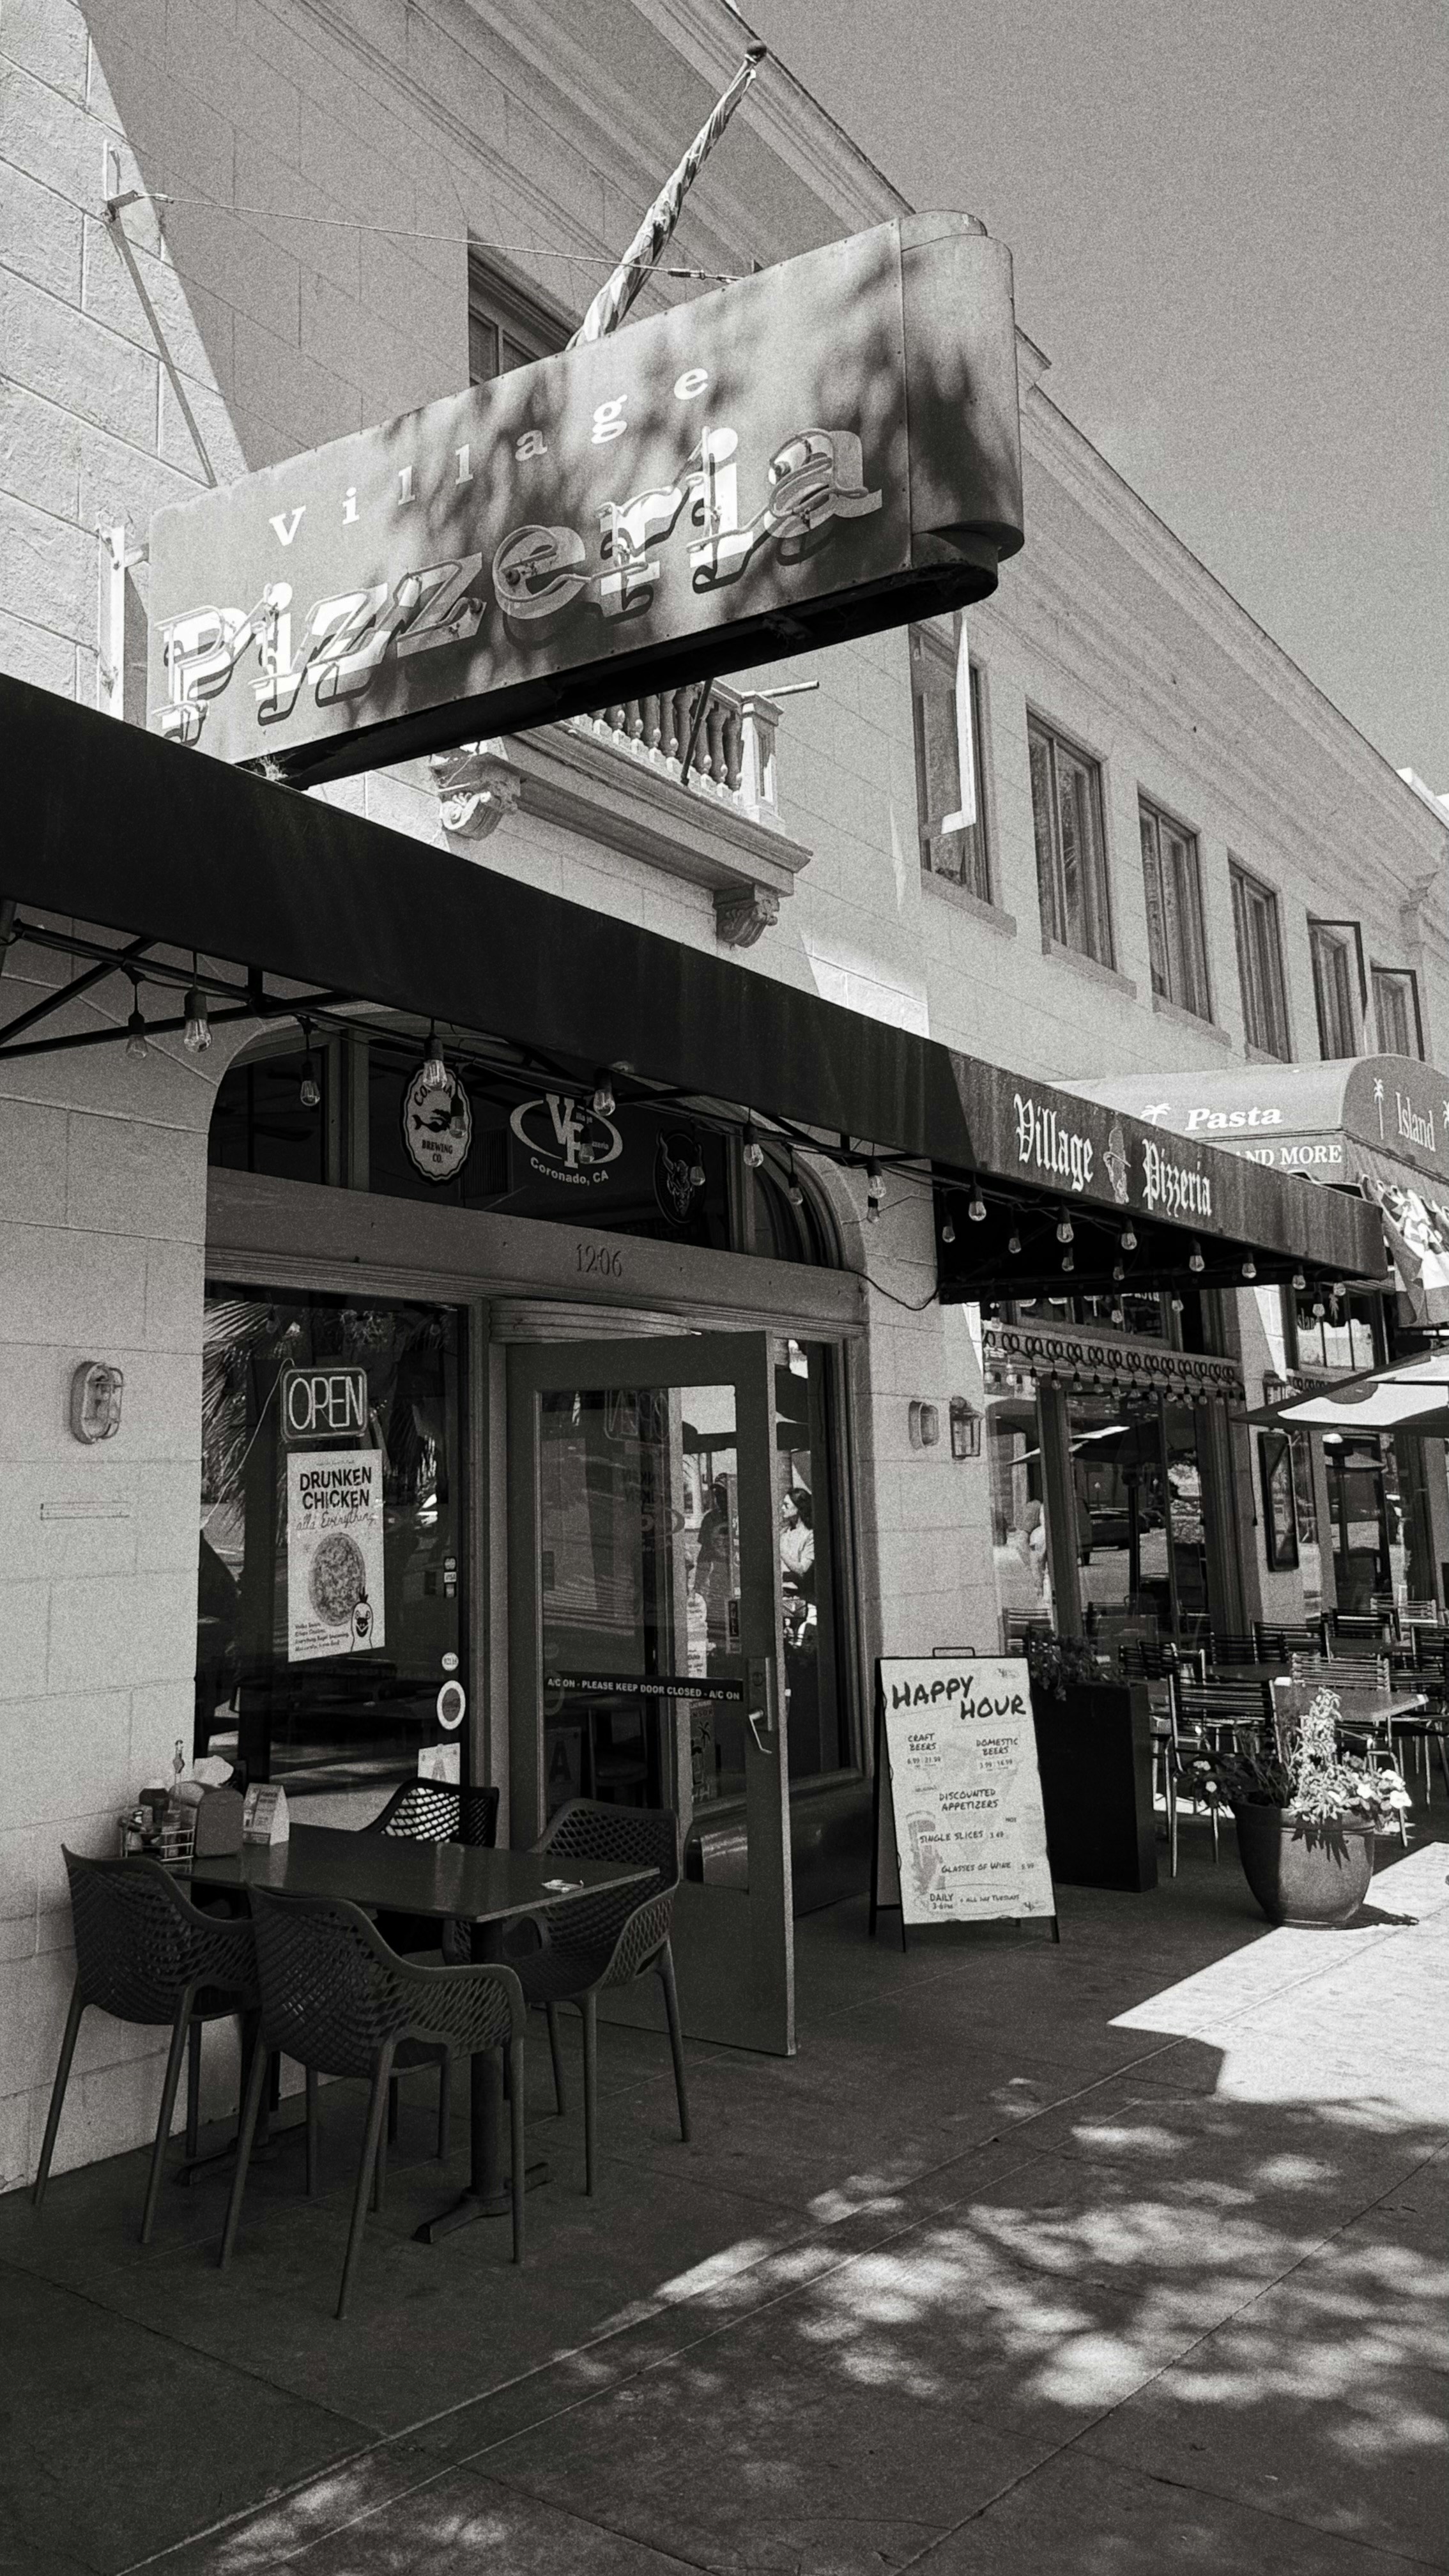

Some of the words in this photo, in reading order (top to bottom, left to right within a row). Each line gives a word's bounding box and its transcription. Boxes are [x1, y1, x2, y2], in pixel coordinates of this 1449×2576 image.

[269, 367, 709, 546] village
[153, 426, 882, 728] Pizzeria
[1184, 1107, 1283, 1131] Pasta
[1395, 1092, 1436, 1152] Island
[422, 1139, 453, 1155] BREWING
[1014, 1093, 1093, 1192] Village
[1142, 1138, 1212, 1218] Pizzeria
[1235, 1148, 1275, 1167] ND
[1280, 1144, 1342, 1165] MORE
[530, 1157, 590, 1186] Coronado,
[593, 1170, 609, 1183] CA
[577, 1244, 622, 1277] 1206
[288, 1375, 364, 1430] OPEN
[300, 1466, 372, 1491] DRUNKEN
[302, 1489, 369, 1510] CHICKEN
[548, 1678, 563, 1686] A/C
[563, 1679, 575, 1687] ON
[581, 1680, 613, 1690] PLEASE
[616, 1682, 638, 1692] KEEP
[640, 1684, 664, 1694] DOOR
[667, 1687, 702, 1698] CLOSED
[709, 1690, 724, 1699] A/C
[726, 1691, 740, 1701] ON
[892, 1675, 974, 1710] HAPPY
[960, 1694, 1026, 1720] HOUR
[907, 1732, 935, 1742] CRAFT
[909, 1742, 937, 1751] BEERS
[976, 1738, 1019, 1747] DOMESTIC
[982, 1745, 1009, 1756] BEERS
[939, 1789, 996, 1801] DISCOUNTED
[941, 1798, 999, 1812] APPETIZERS
[919, 1832, 951, 1844] SINGLE
[954, 1830, 984, 1841] SLICES
[941, 1864, 975, 1873] GLASSES
[930, 1893, 954, 1902] DAILY
